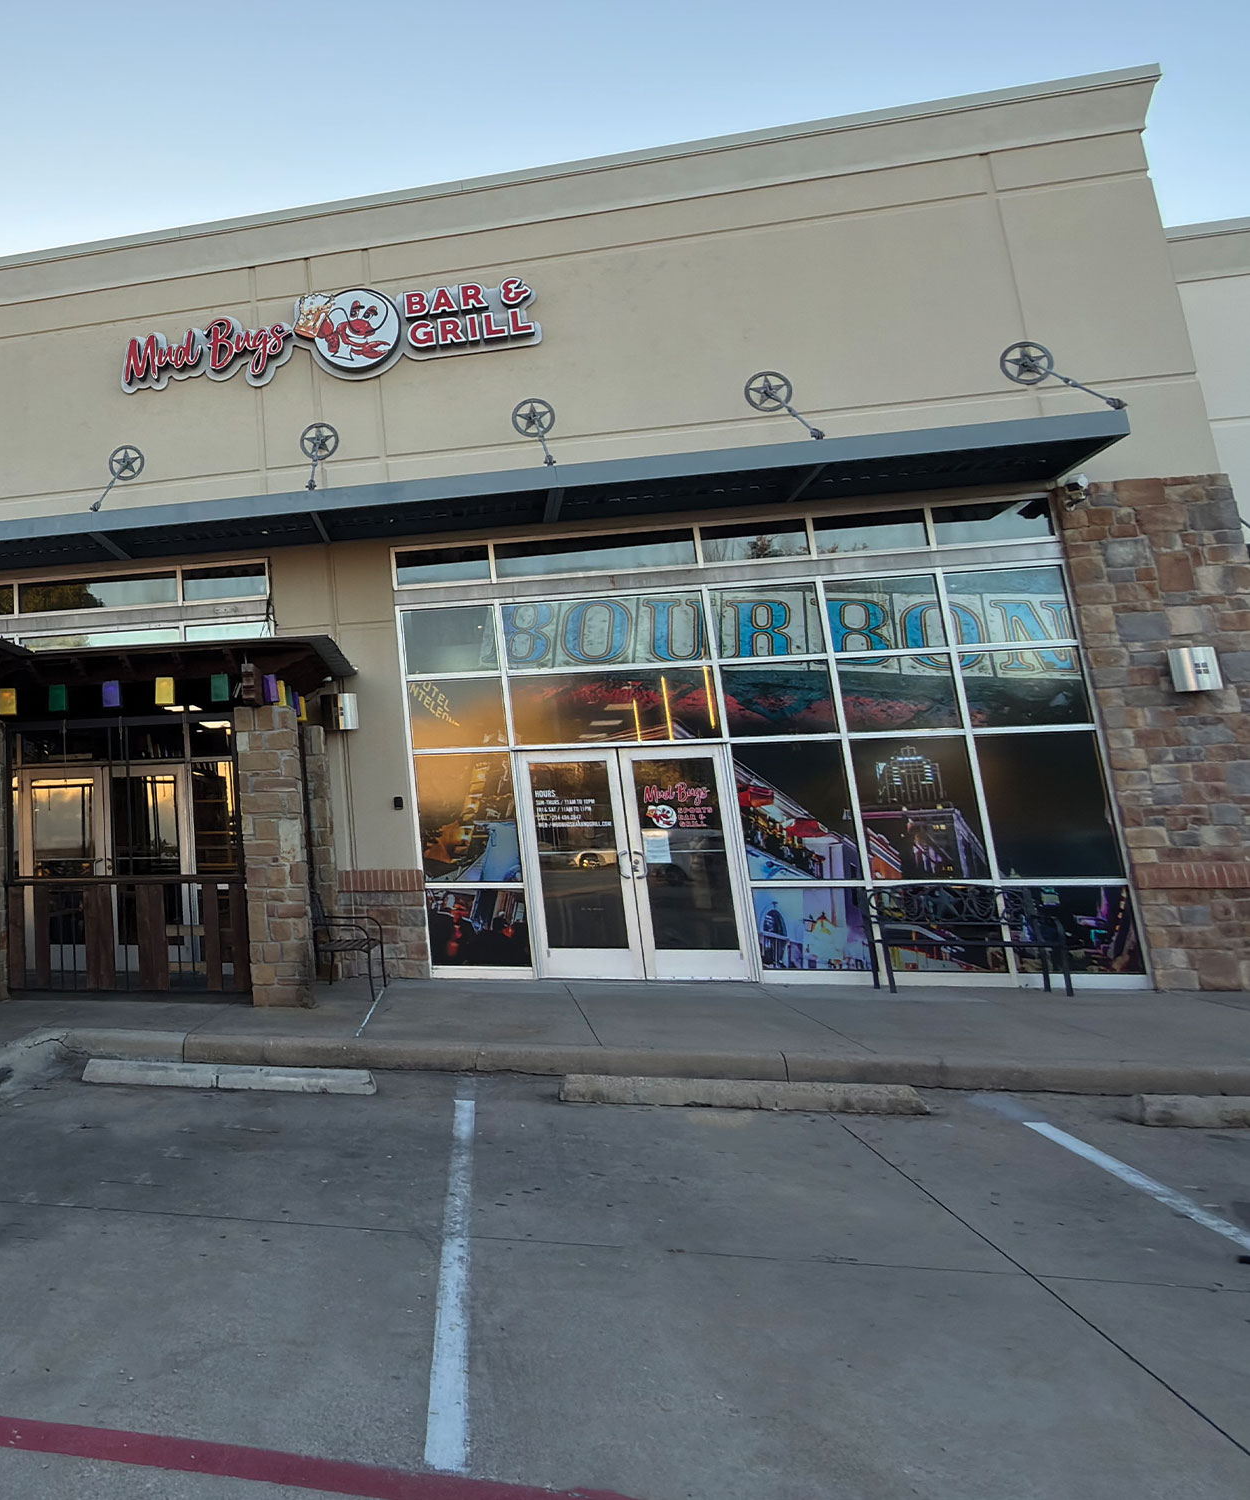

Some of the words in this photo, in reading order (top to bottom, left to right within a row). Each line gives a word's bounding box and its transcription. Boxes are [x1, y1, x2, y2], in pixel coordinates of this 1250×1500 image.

[403, 283, 490, 318] BAR
[500, 277, 532, 305] &
[407, 308, 535, 348] GRILL
[125, 328, 201, 384] Mud
[203, 318, 293, 377] Bugs
[488, 597, 1079, 673] BOURBON
[534, 790, 557, 798] HOURS
[644, 785, 676, 803] Mud
[675, 782, 710, 806] Bugs
